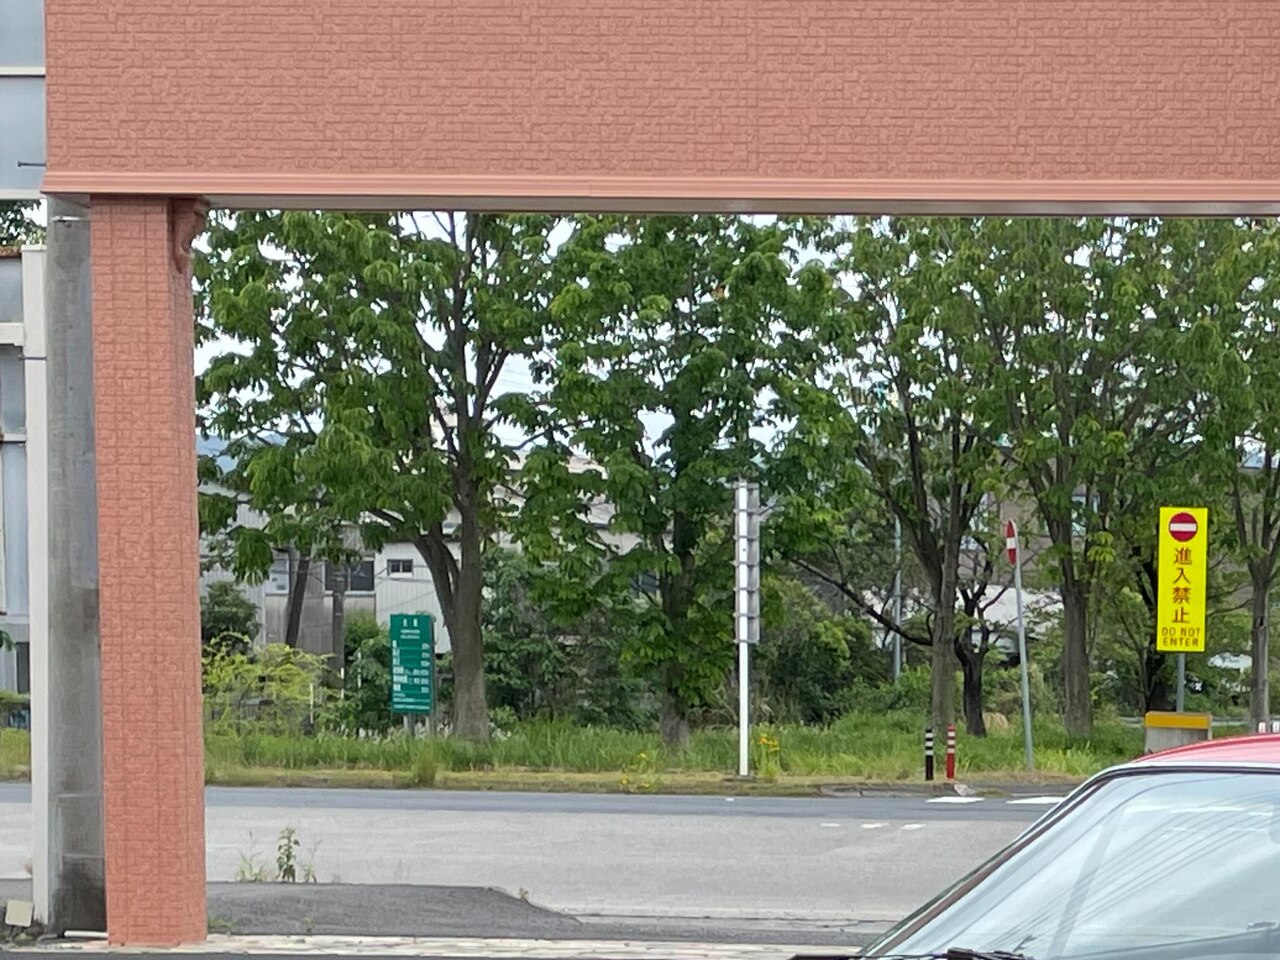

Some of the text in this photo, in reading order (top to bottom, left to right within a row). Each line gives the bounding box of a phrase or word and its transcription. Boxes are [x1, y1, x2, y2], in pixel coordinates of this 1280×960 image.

[1173, 547, 1192, 623] 進入禁止
[1162, 627, 1201, 637] DO NOT
[1162, 637, 1199, 647] ENTER
